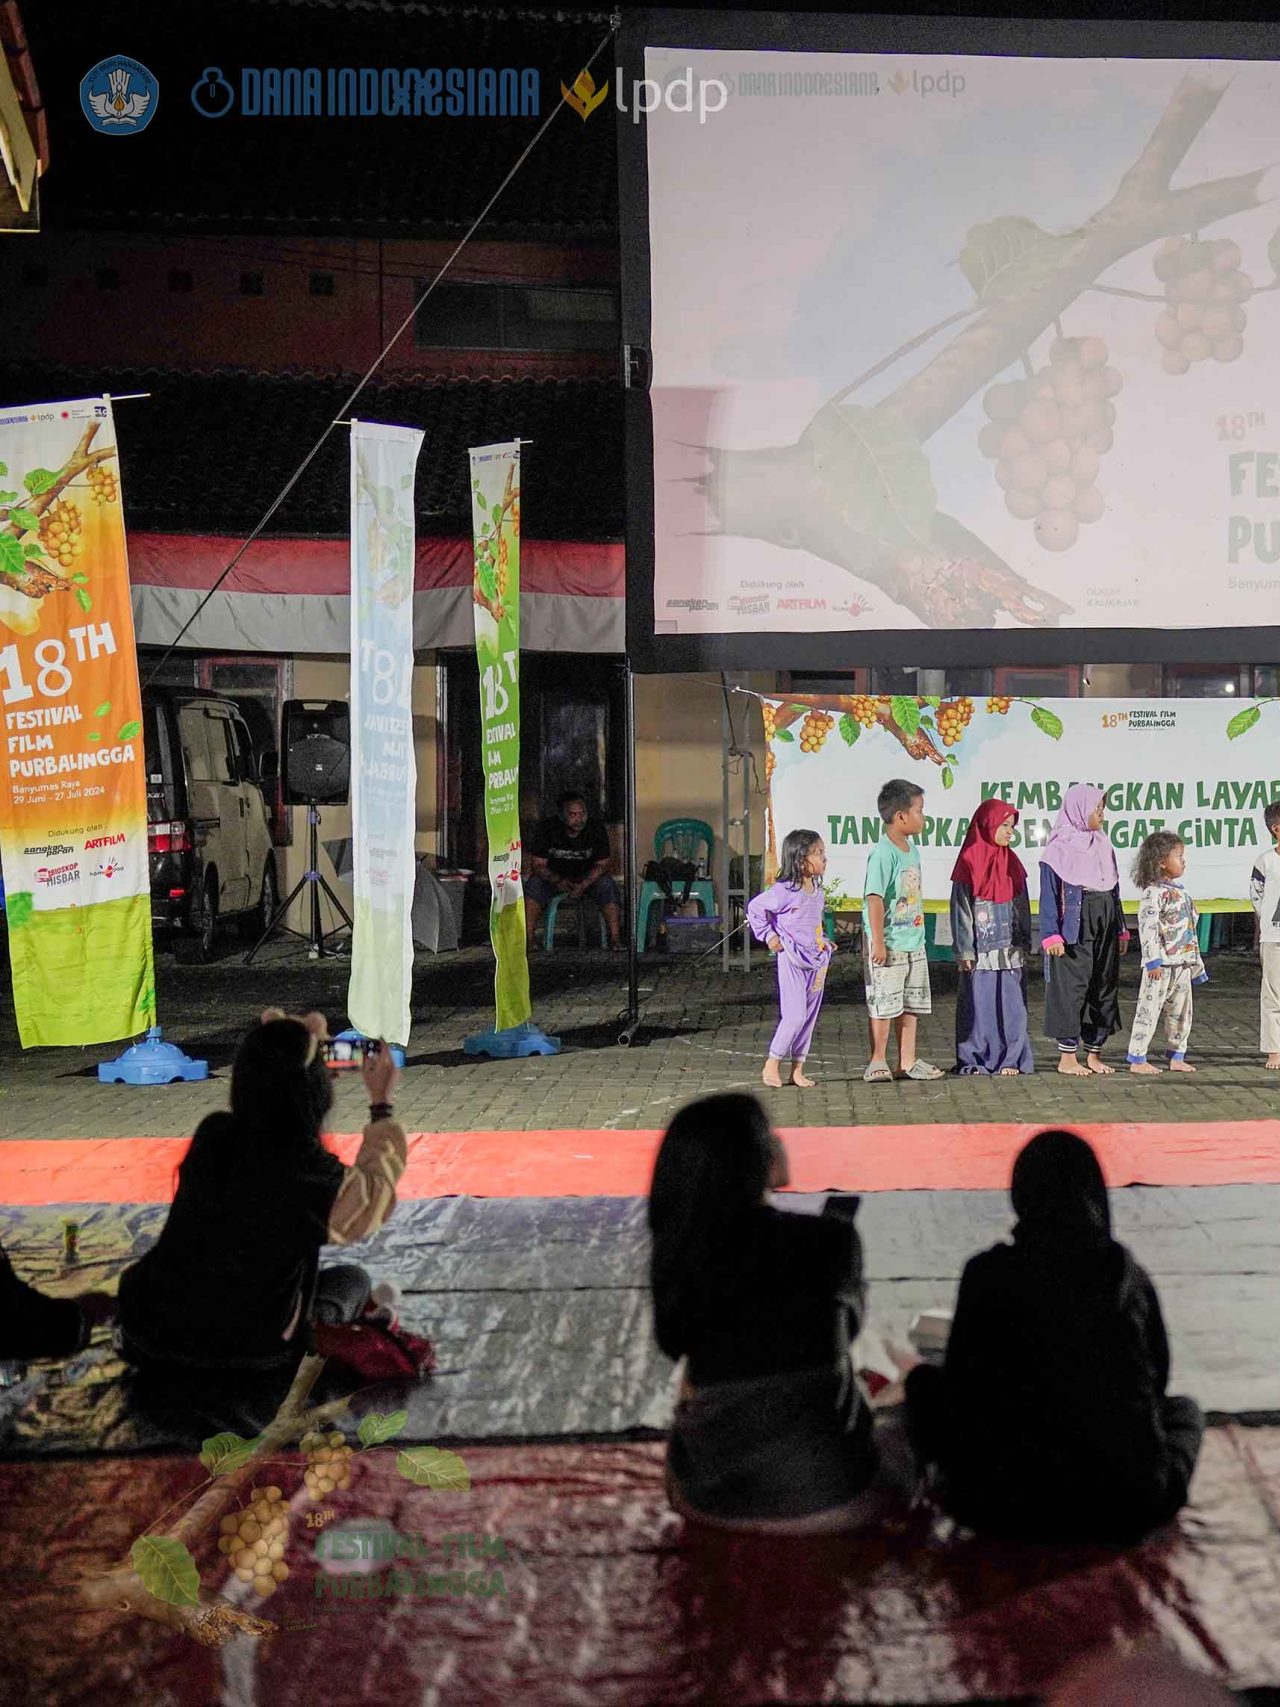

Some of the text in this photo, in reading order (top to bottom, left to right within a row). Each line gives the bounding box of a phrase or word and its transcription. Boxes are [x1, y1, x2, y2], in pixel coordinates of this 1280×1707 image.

[912, 69, 966, 98] lpdp
[0, 622, 117, 705] 18TH
[6, 704, 83, 730] FESTIVAL
[1101, 712, 1129, 728] 18TH
[1129, 710, 1177, 718] FESTIVAL FILM
[1128, 719, 1176, 728] PURBALINGGA
[8, 734, 54, 754] FILM
[9, 743, 136, 778] PURBALINGGA
[12, 780, 81, 796] Banyumas Raya
[13, 787, 105, 805] 29 Juni 27 Juli 2024
[980, 780, 1184, 812] KEMBGKAN
[48, 827, 84, 838] Didukung
[84, 833, 126, 850] ARTFILM
